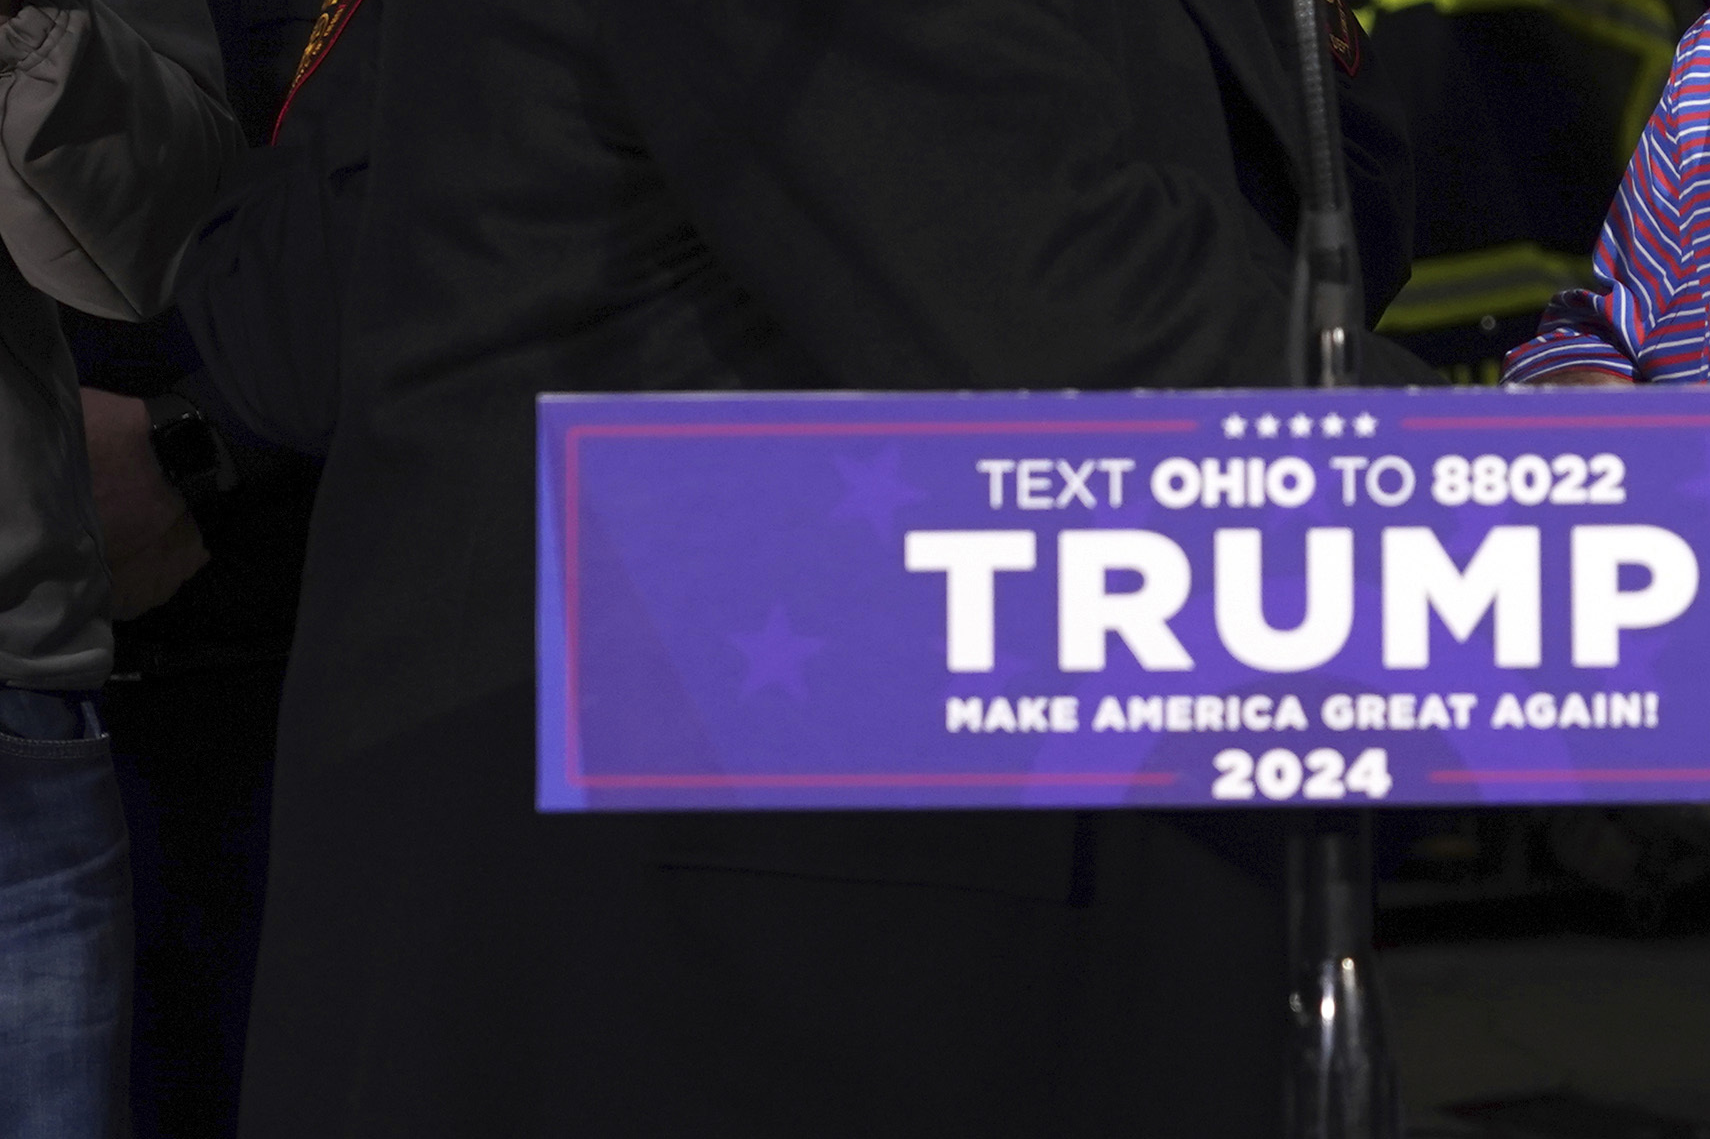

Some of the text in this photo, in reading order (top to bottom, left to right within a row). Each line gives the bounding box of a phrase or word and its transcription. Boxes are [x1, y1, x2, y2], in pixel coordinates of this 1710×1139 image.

[977, 453, 1627, 510] TEXT OHIO TO 88022
[903, 524, 1701, 674] TRUMP
[946, 692, 1660, 733] MAKE AMERICA GREAT AGAIN!
[1211, 747, 1393, 801] 2024
